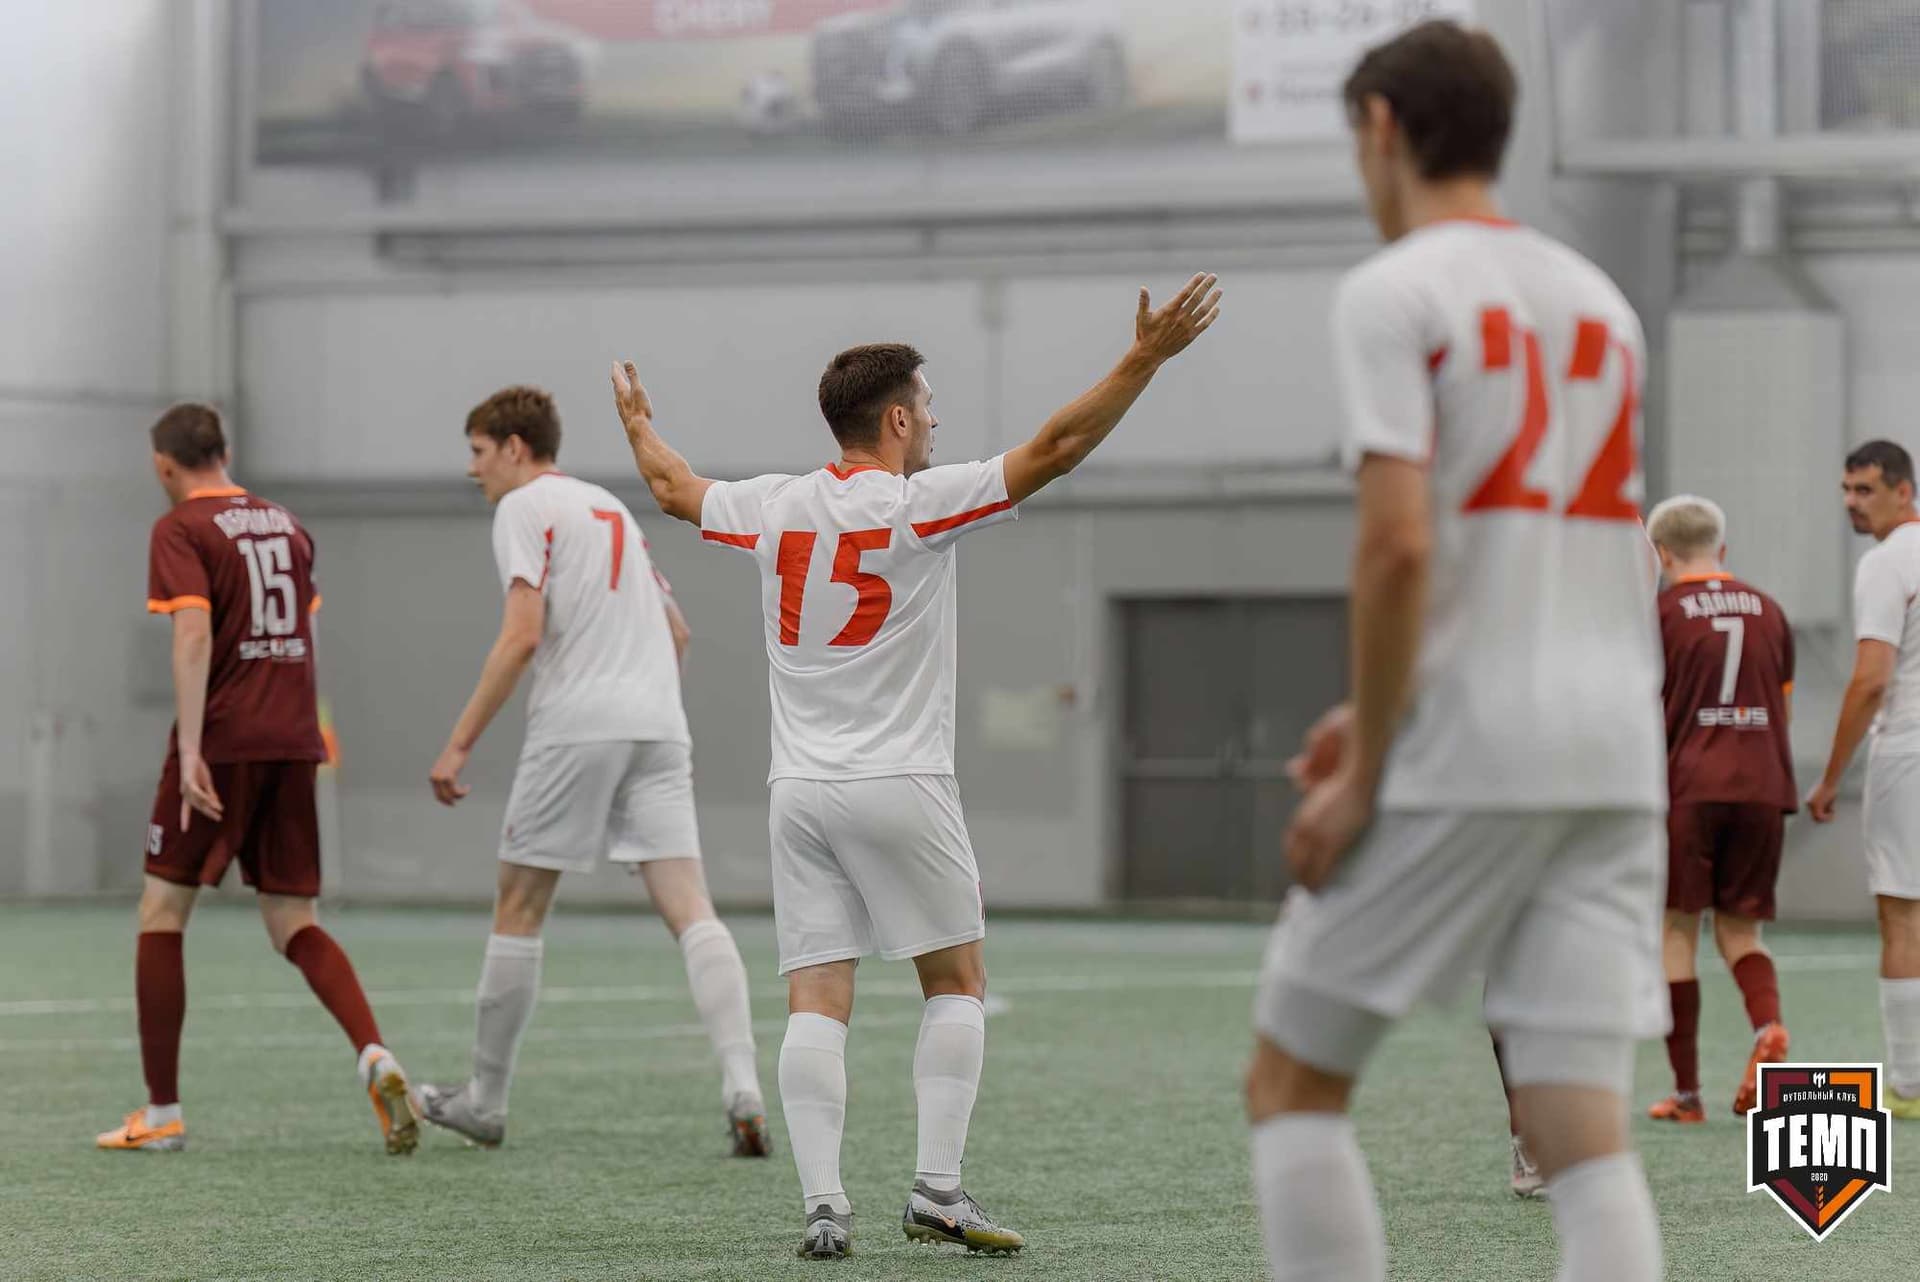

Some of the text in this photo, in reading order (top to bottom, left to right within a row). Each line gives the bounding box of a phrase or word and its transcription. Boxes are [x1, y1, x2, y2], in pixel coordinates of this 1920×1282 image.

[1461, 306, 1642, 520] 22
[236, 537, 298, 637] 15
[592, 509, 625, 591] 7
[776, 527, 893, 647] 15
[1711, 616, 1745, 704] 7
